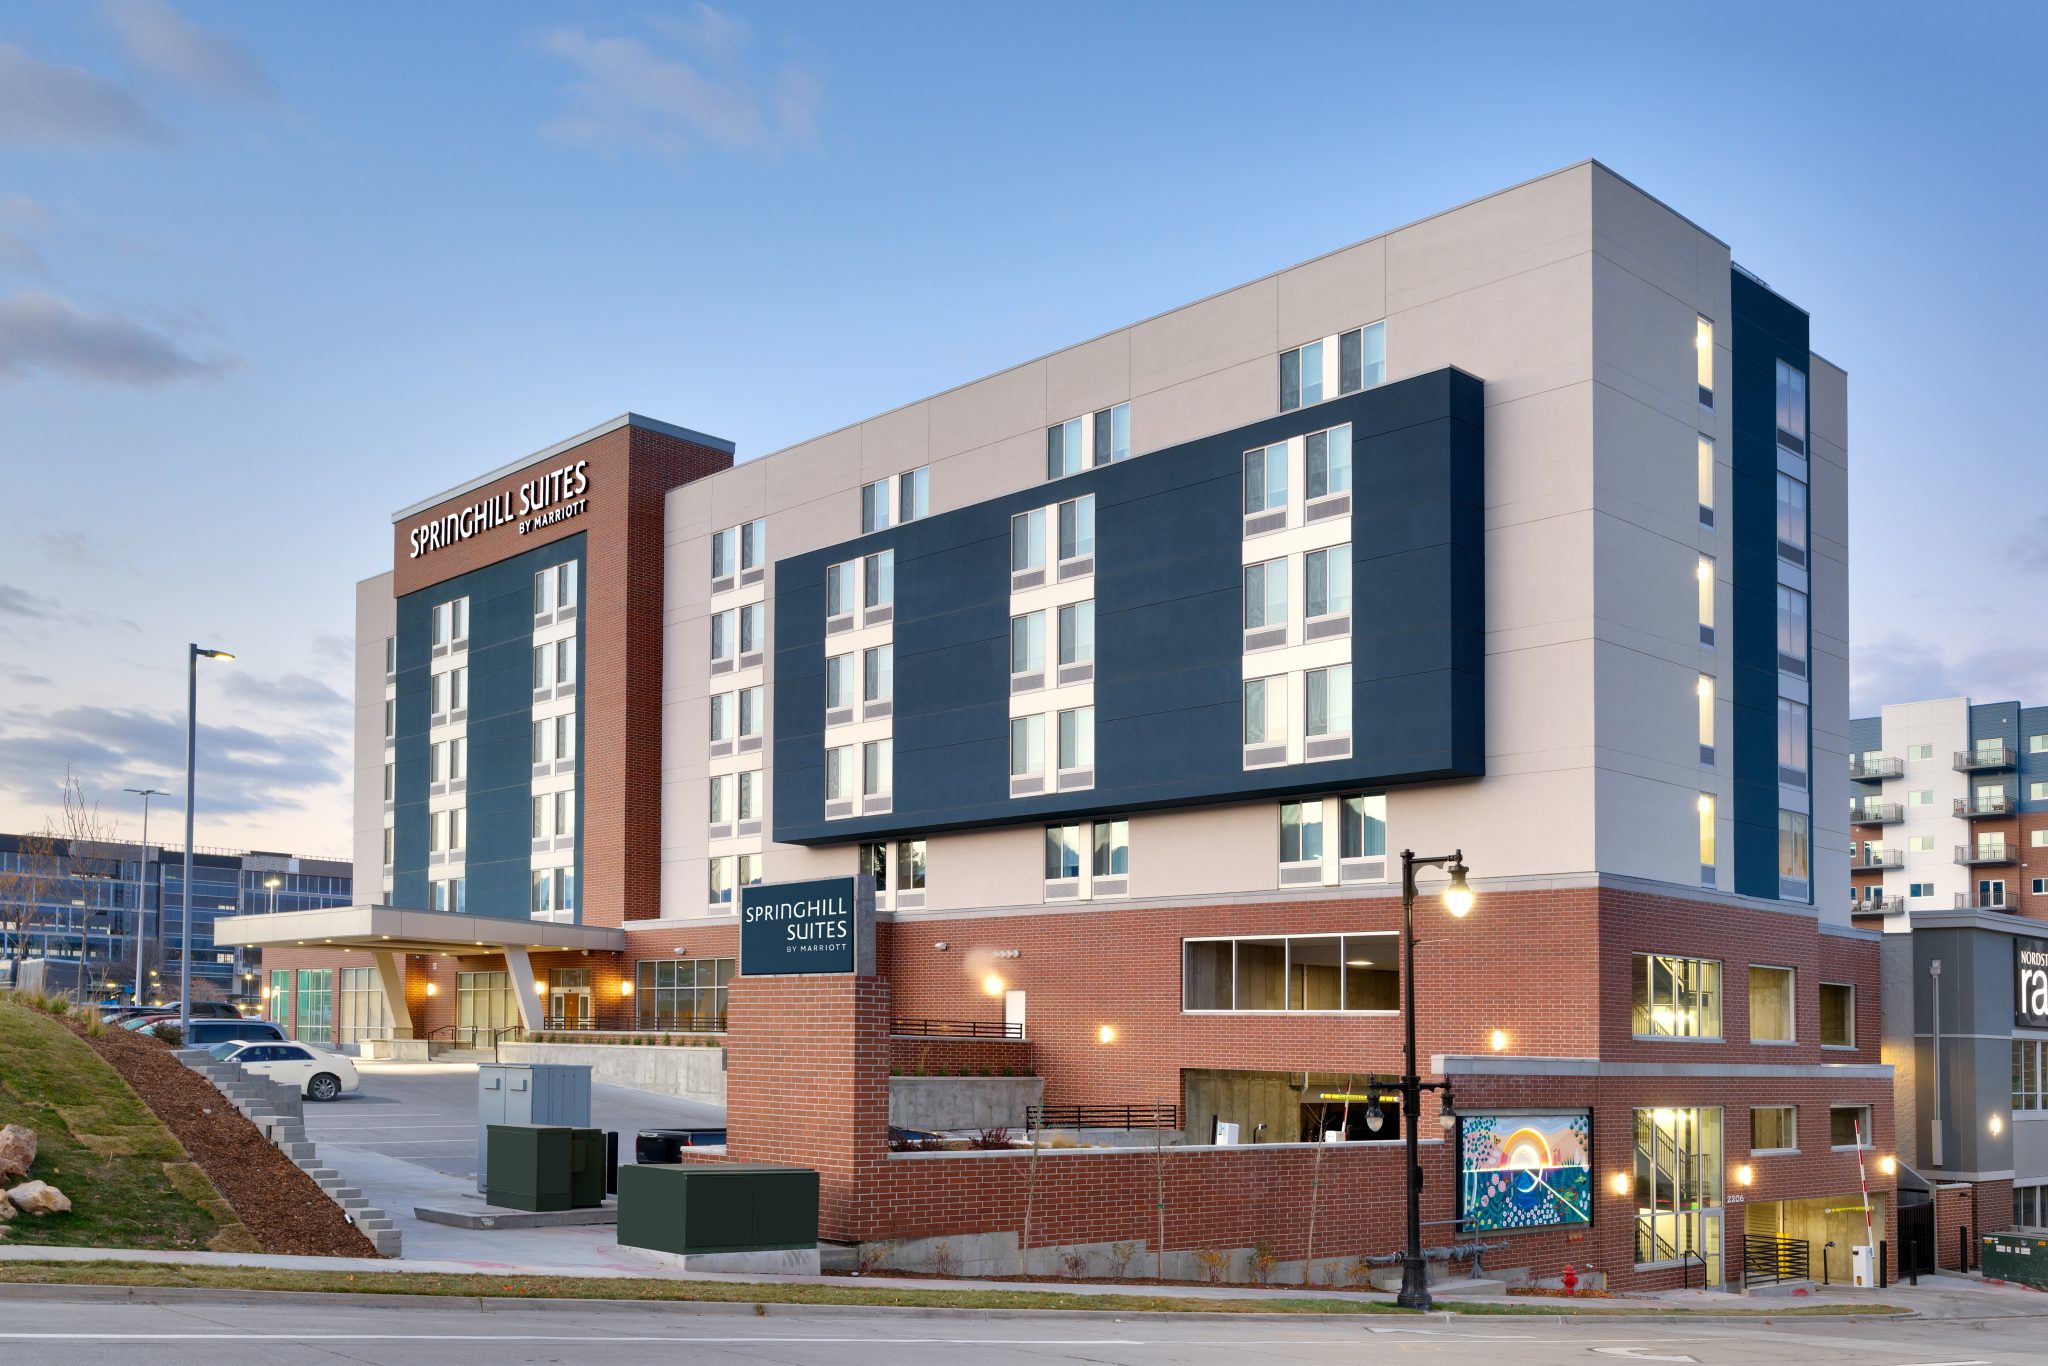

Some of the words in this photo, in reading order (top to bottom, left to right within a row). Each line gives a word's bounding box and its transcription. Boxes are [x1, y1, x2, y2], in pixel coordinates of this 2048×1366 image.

[410, 491, 515, 559] SPRINGHILL
[519, 460, 588, 516] SUITES
[519, 519, 531, 535] BY
[534, 499, 587, 530] MARRIOTT
[746, 897, 847, 922] SPRINGHILL
[787, 921, 847, 940] SUITES
[786, 945, 798, 953] BY
[800, 943, 847, 952] MARRIOTT
